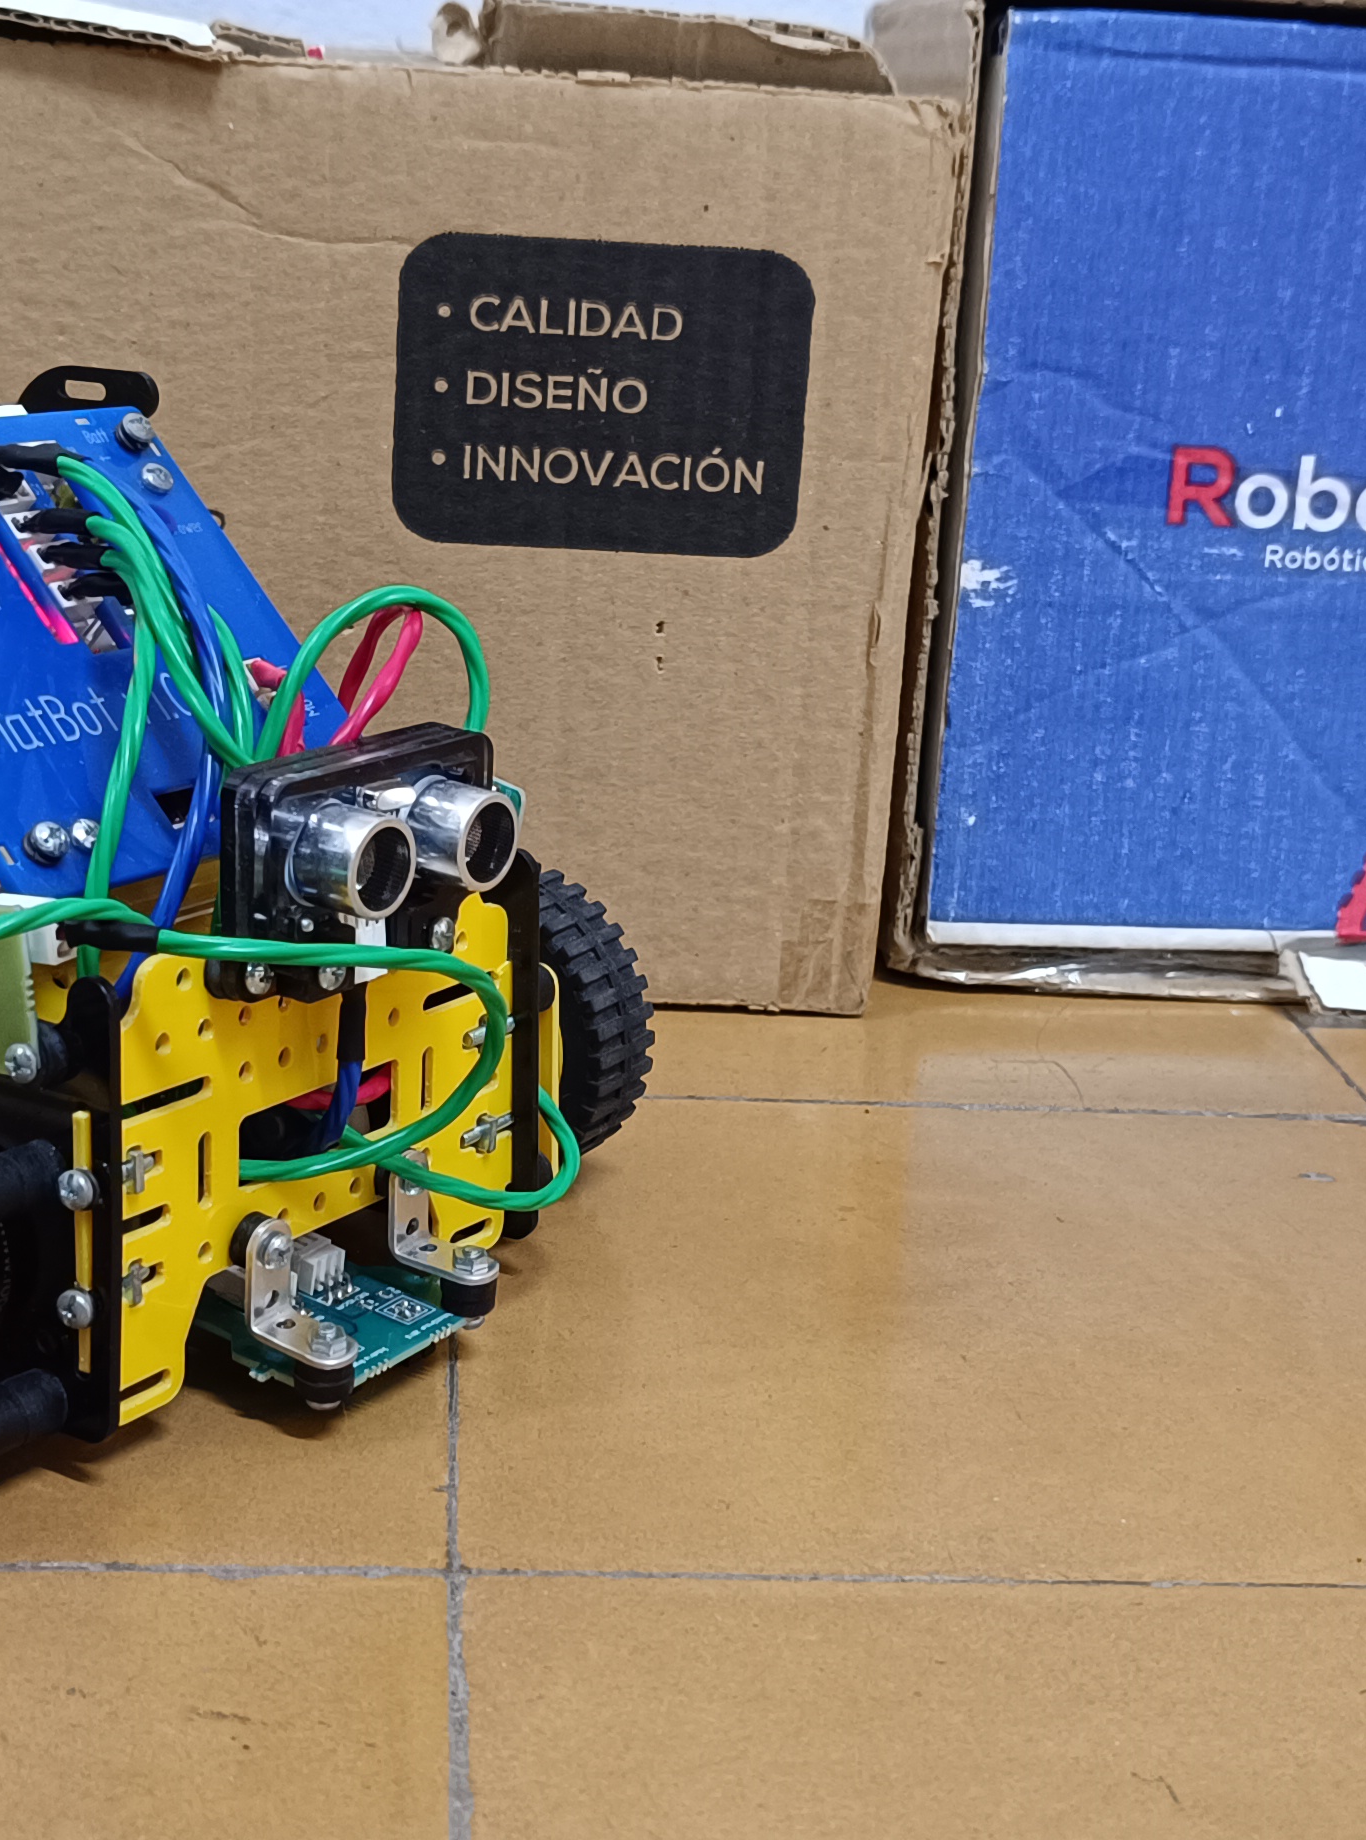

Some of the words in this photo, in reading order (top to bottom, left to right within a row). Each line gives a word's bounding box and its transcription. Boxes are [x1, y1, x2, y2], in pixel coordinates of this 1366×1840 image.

[469, 296, 684, 342] CALIDAD
[466, 367, 649, 415] DISEÑO
[463, 445, 766, 496] INNOVACIÓN
